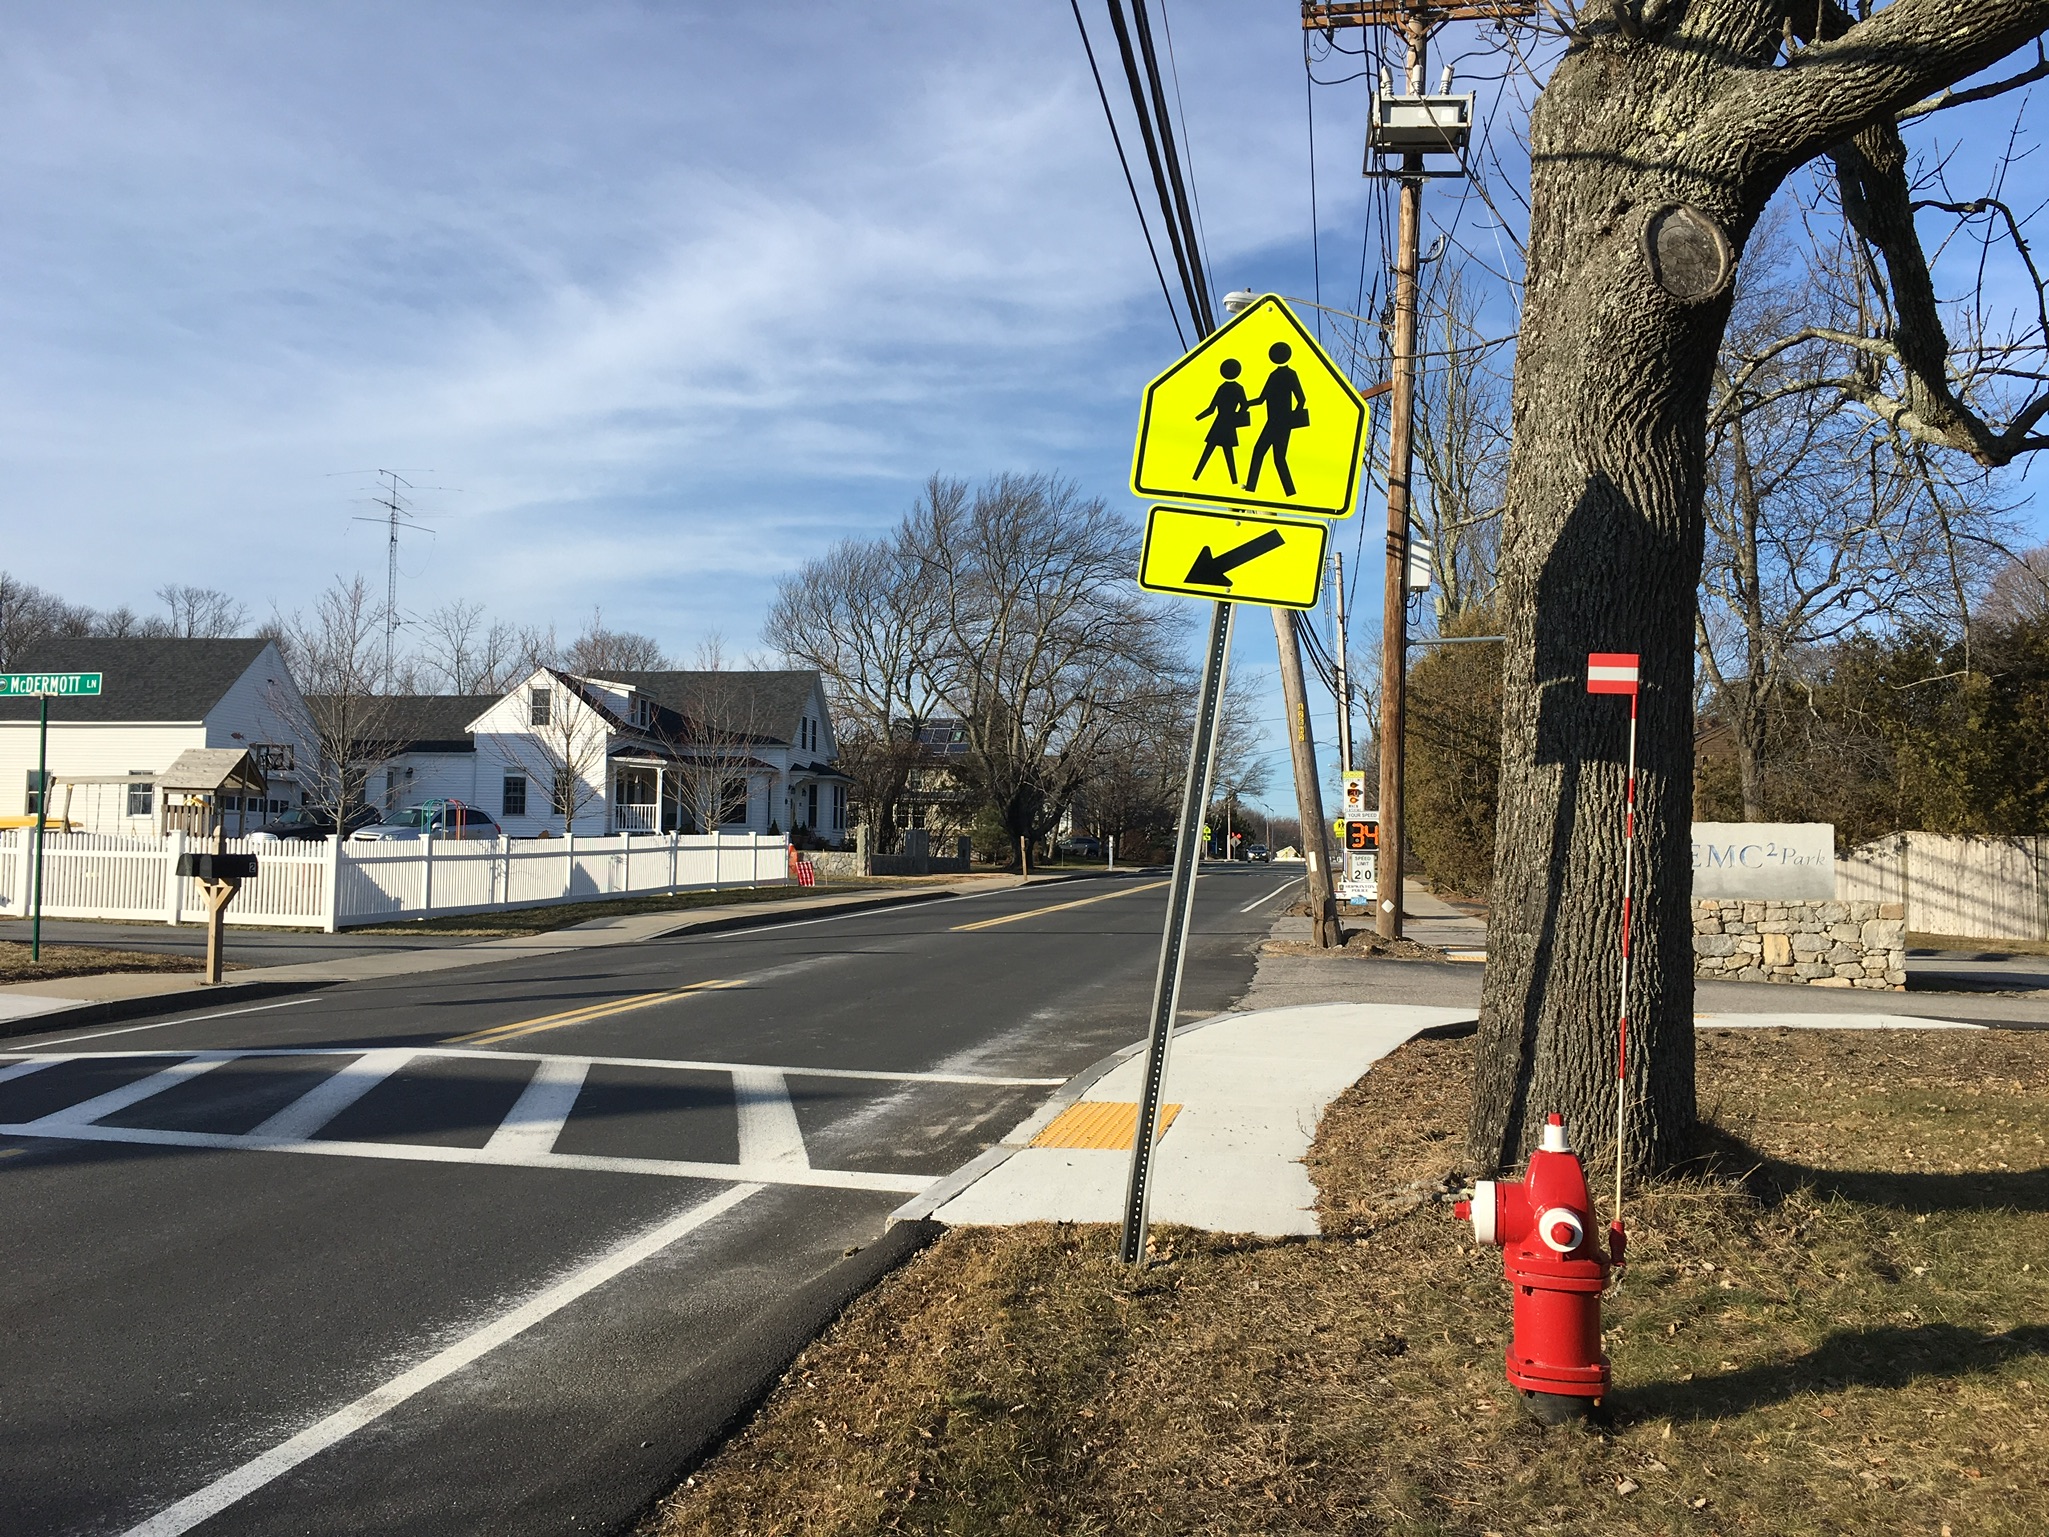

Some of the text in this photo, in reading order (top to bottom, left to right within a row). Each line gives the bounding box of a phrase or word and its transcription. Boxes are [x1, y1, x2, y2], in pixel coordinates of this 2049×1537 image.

[10, 676, 96, 693] McDERMOTT LN
[1352, 823, 1378, 847] 34
[1781, 847, 1826, 866] Park
[1354, 870, 1372, 880] 20
